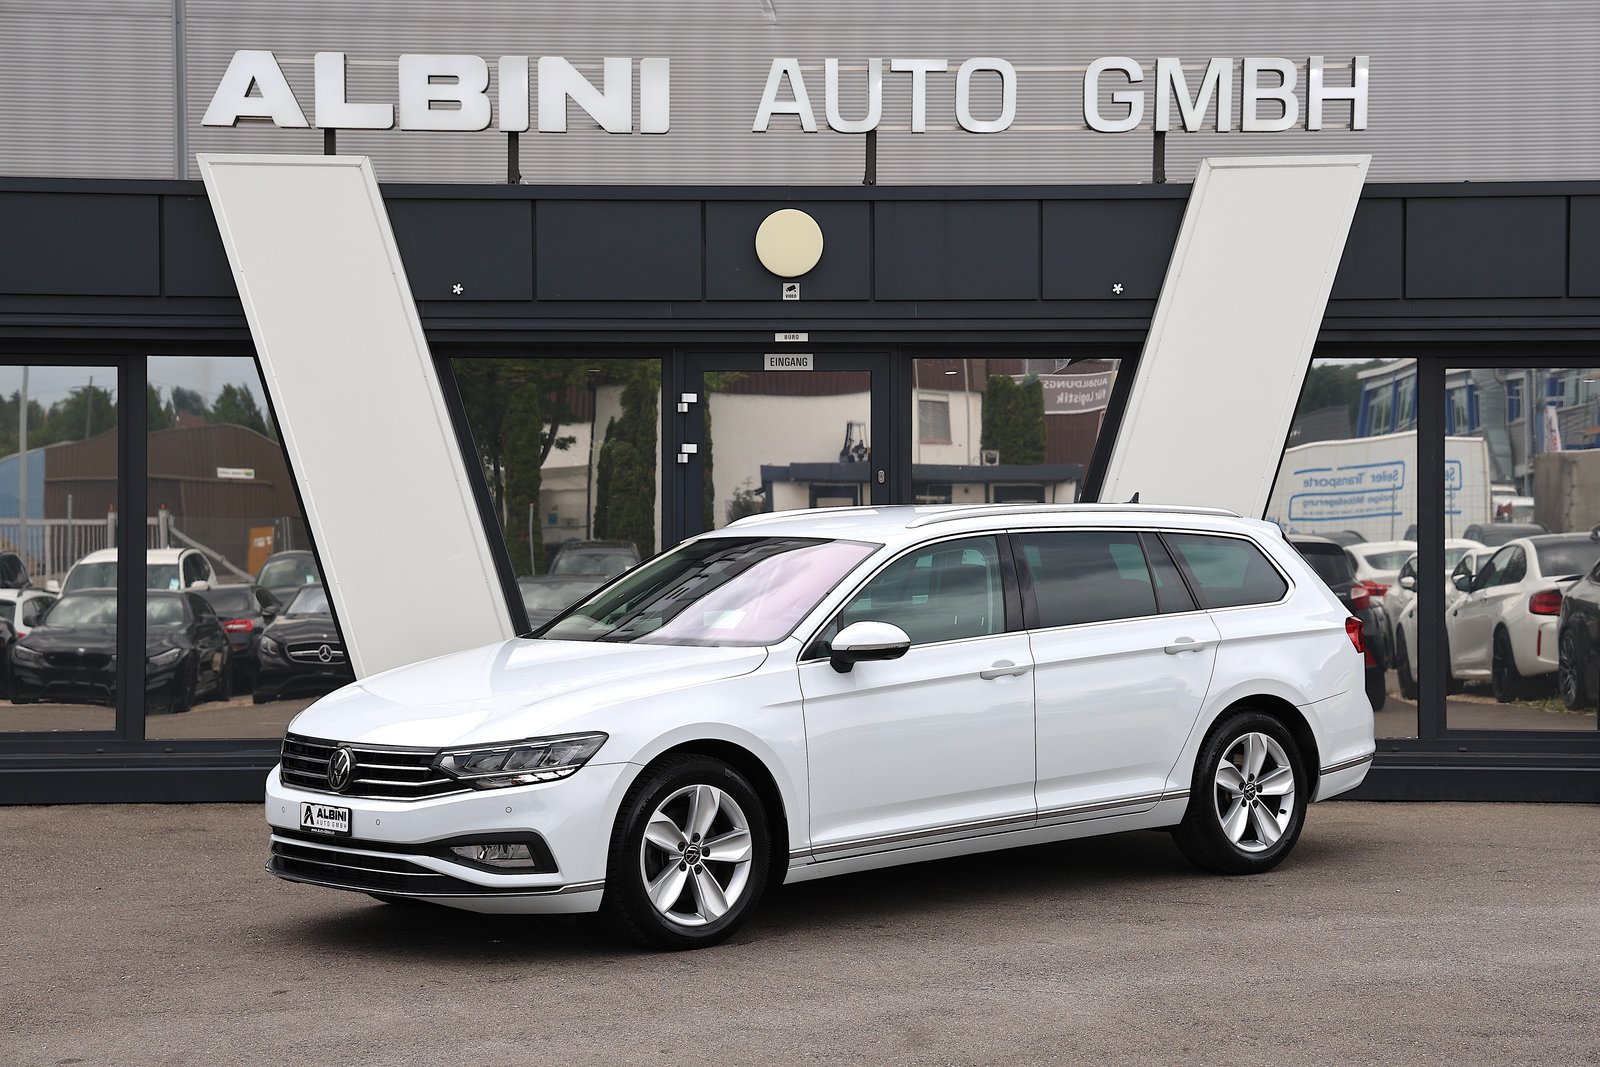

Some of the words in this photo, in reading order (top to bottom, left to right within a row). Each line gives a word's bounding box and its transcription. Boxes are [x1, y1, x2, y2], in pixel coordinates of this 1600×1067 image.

[201, 49, 671, 134] ALBINI
[752, 57, 1018, 134] AUTO
[1083, 55, 1371, 133] GMBH
[770, 357, 808, 367] EINGANG
[316, 807, 347, 822] ALBINI
[332, 821, 347, 829] GMBH
